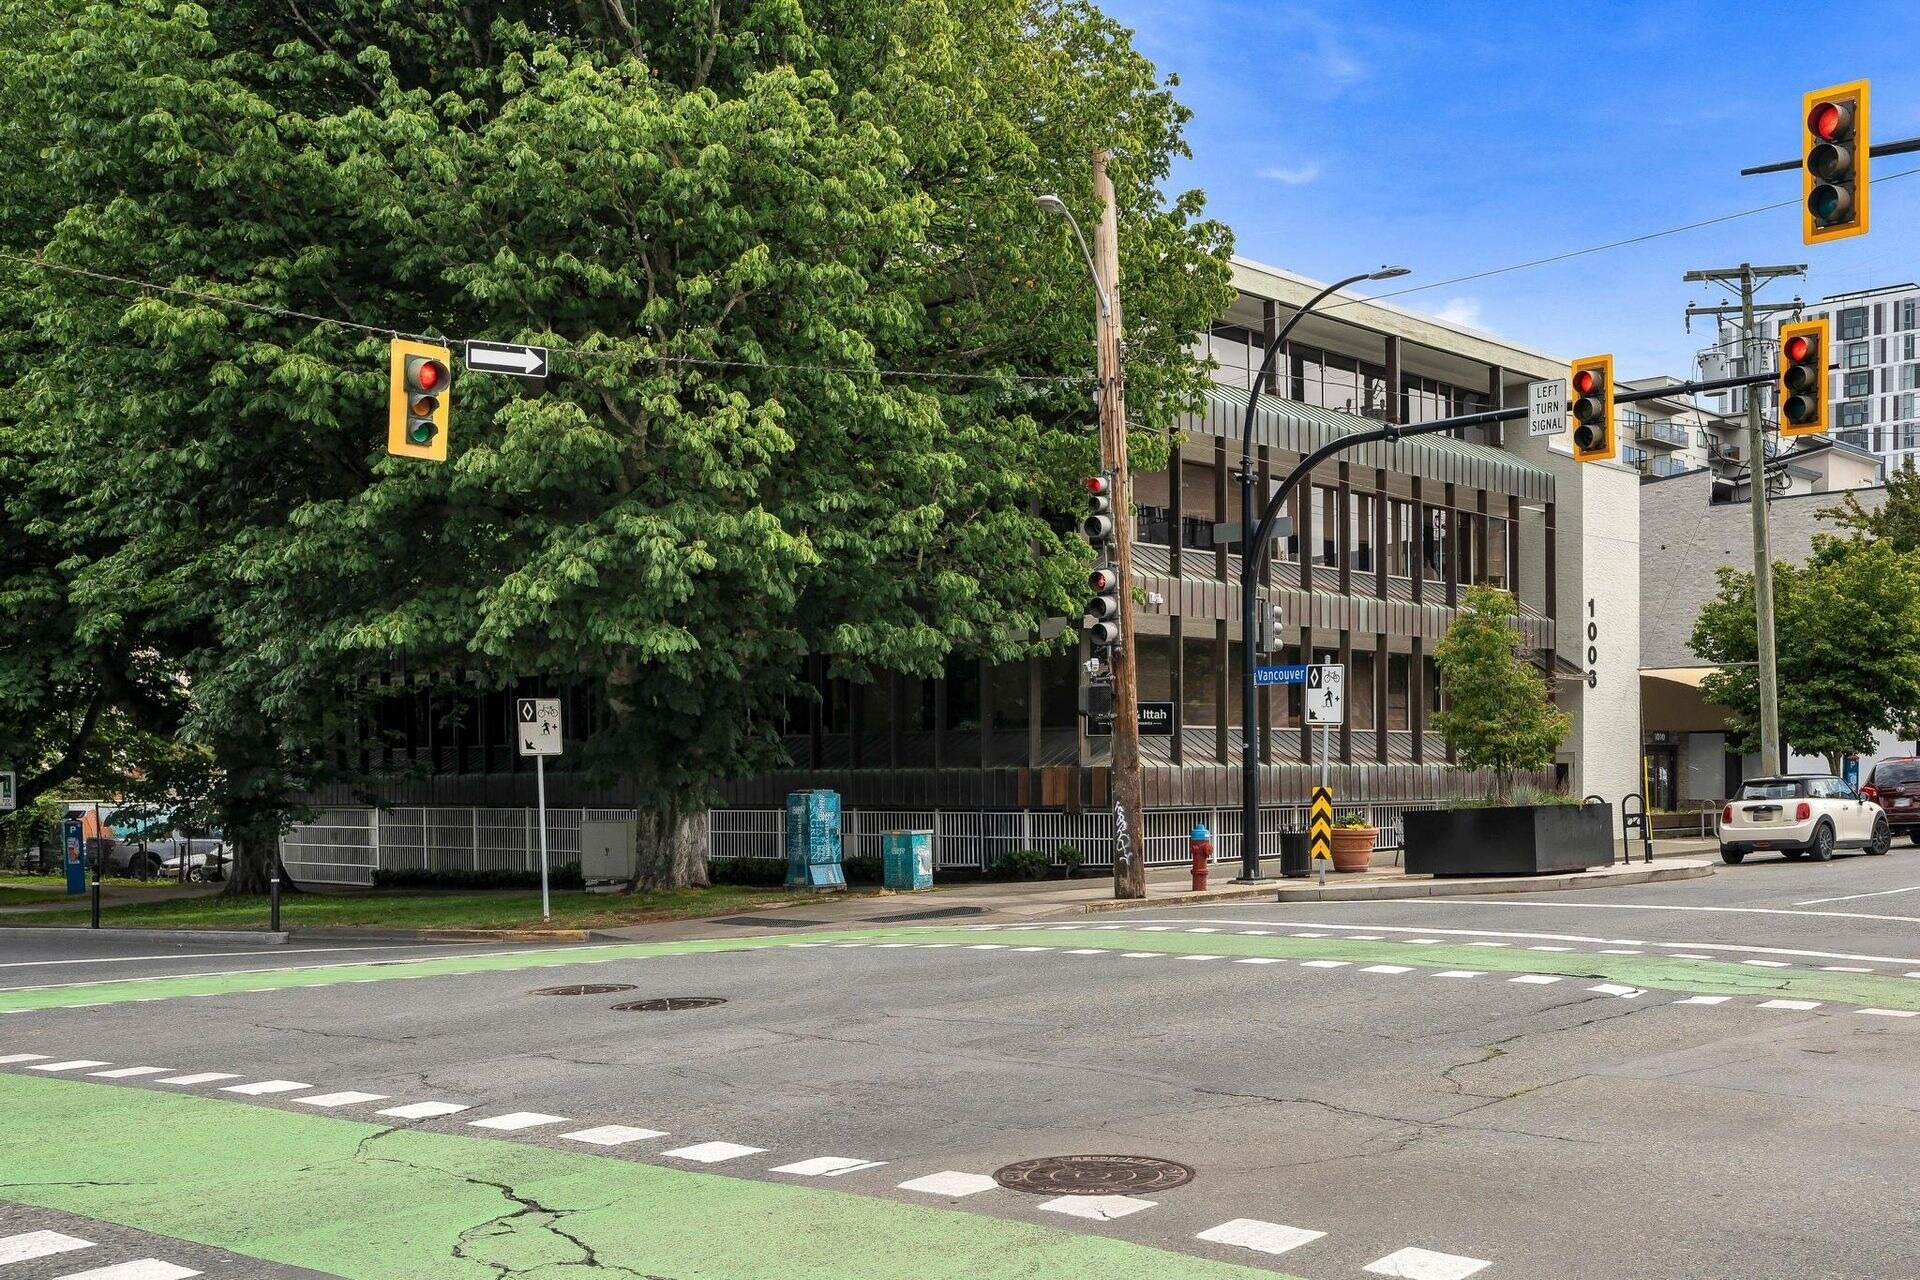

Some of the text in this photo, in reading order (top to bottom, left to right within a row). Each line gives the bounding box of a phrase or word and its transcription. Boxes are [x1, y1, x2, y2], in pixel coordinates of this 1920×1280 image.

[1537, 385, 1558, 398] LEFT
[1536, 401, 1559, 414] TURN
[1532, 418, 1562, 432] SIGNAL
[1257, 669, 1304, 681] Vancouver
[1143, 709, 1167, 719] Ittah
[70, 825, 77, 834] P
